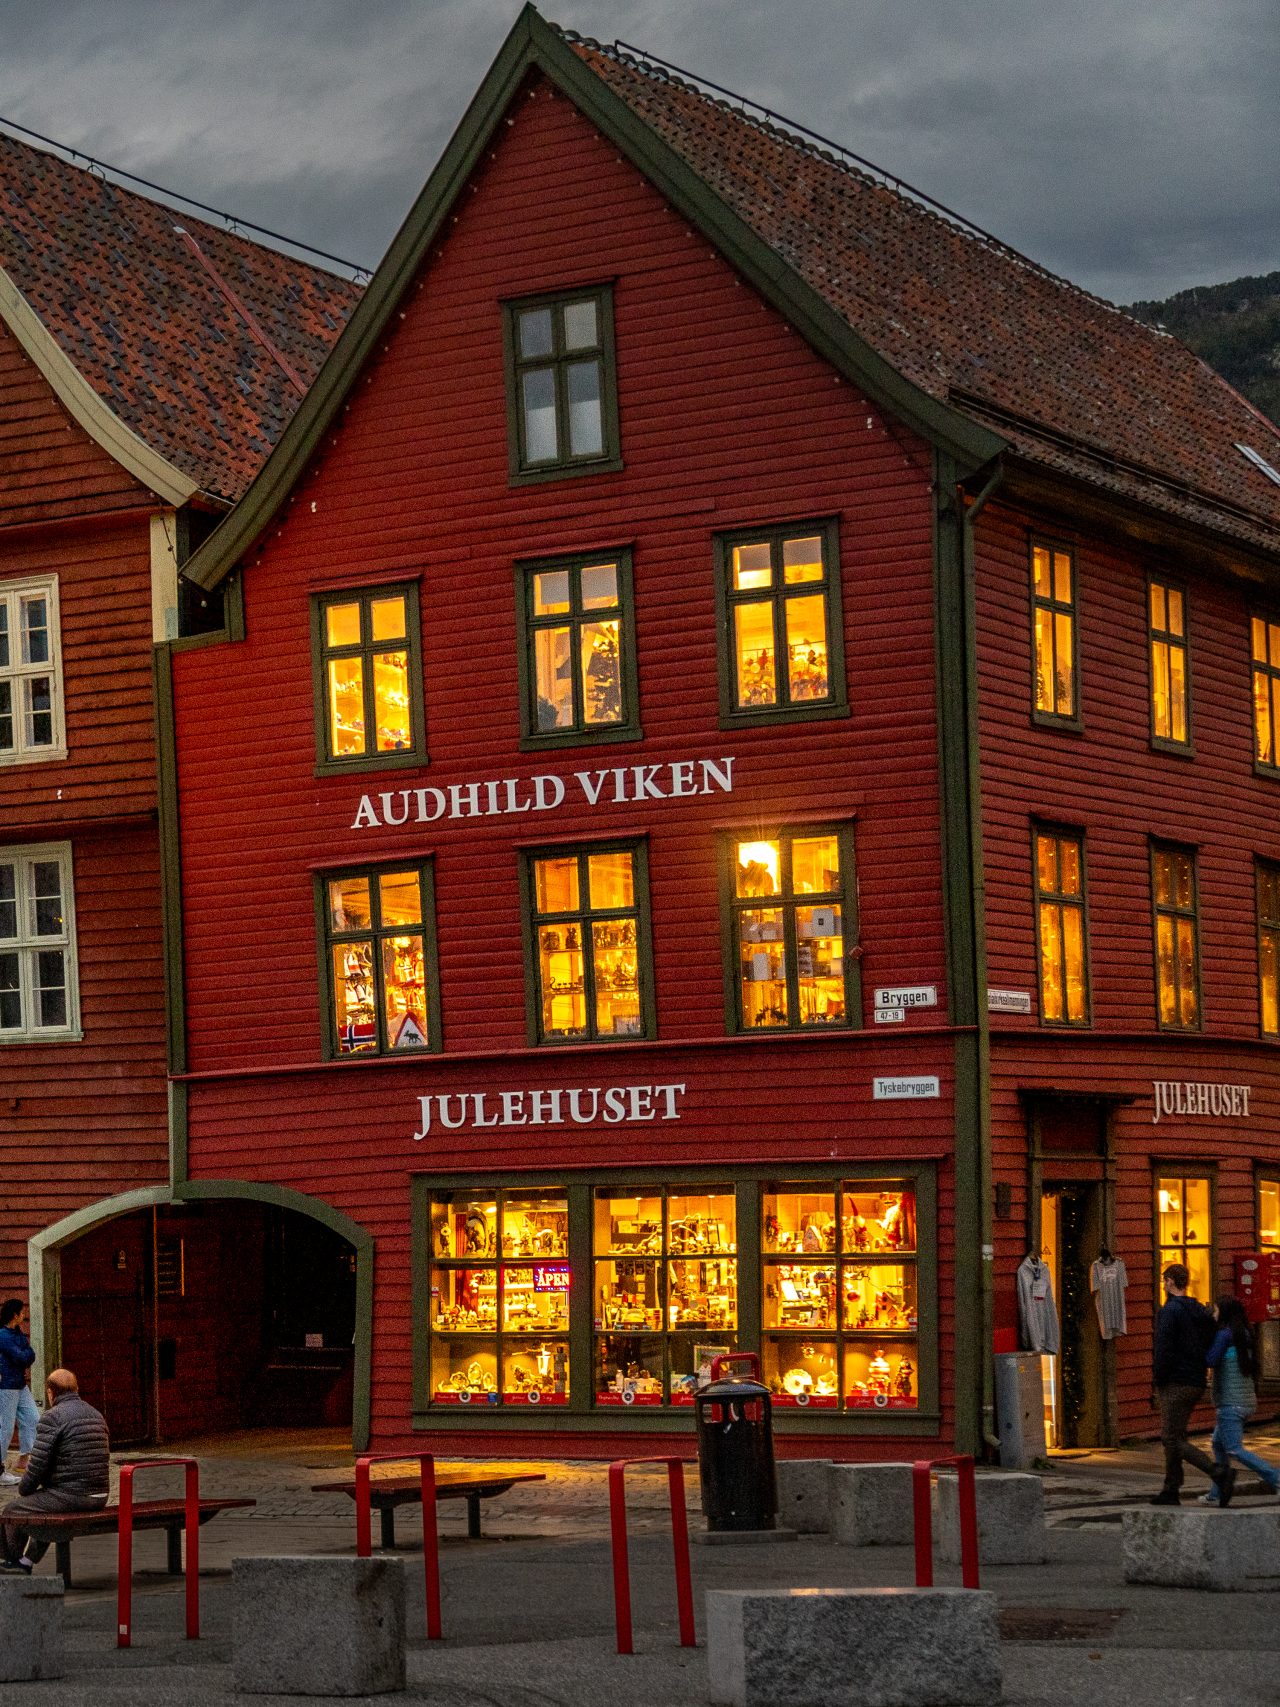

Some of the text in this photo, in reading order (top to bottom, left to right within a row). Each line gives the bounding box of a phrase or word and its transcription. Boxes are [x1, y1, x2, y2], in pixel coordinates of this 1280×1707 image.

[350, 757, 735, 829] AUDHILD VIKEN
[882, 992, 928, 1006] Bryggen
[880, 1011, 899, 1020] 47-19
[878, 1081, 935, 1096] Tyskebryggen
[1152, 1081, 1251, 1124] JULEHUSET
[413, 1084, 686, 1141] JULEHUSET
[537, 1268, 569, 1287] ÅPEN
